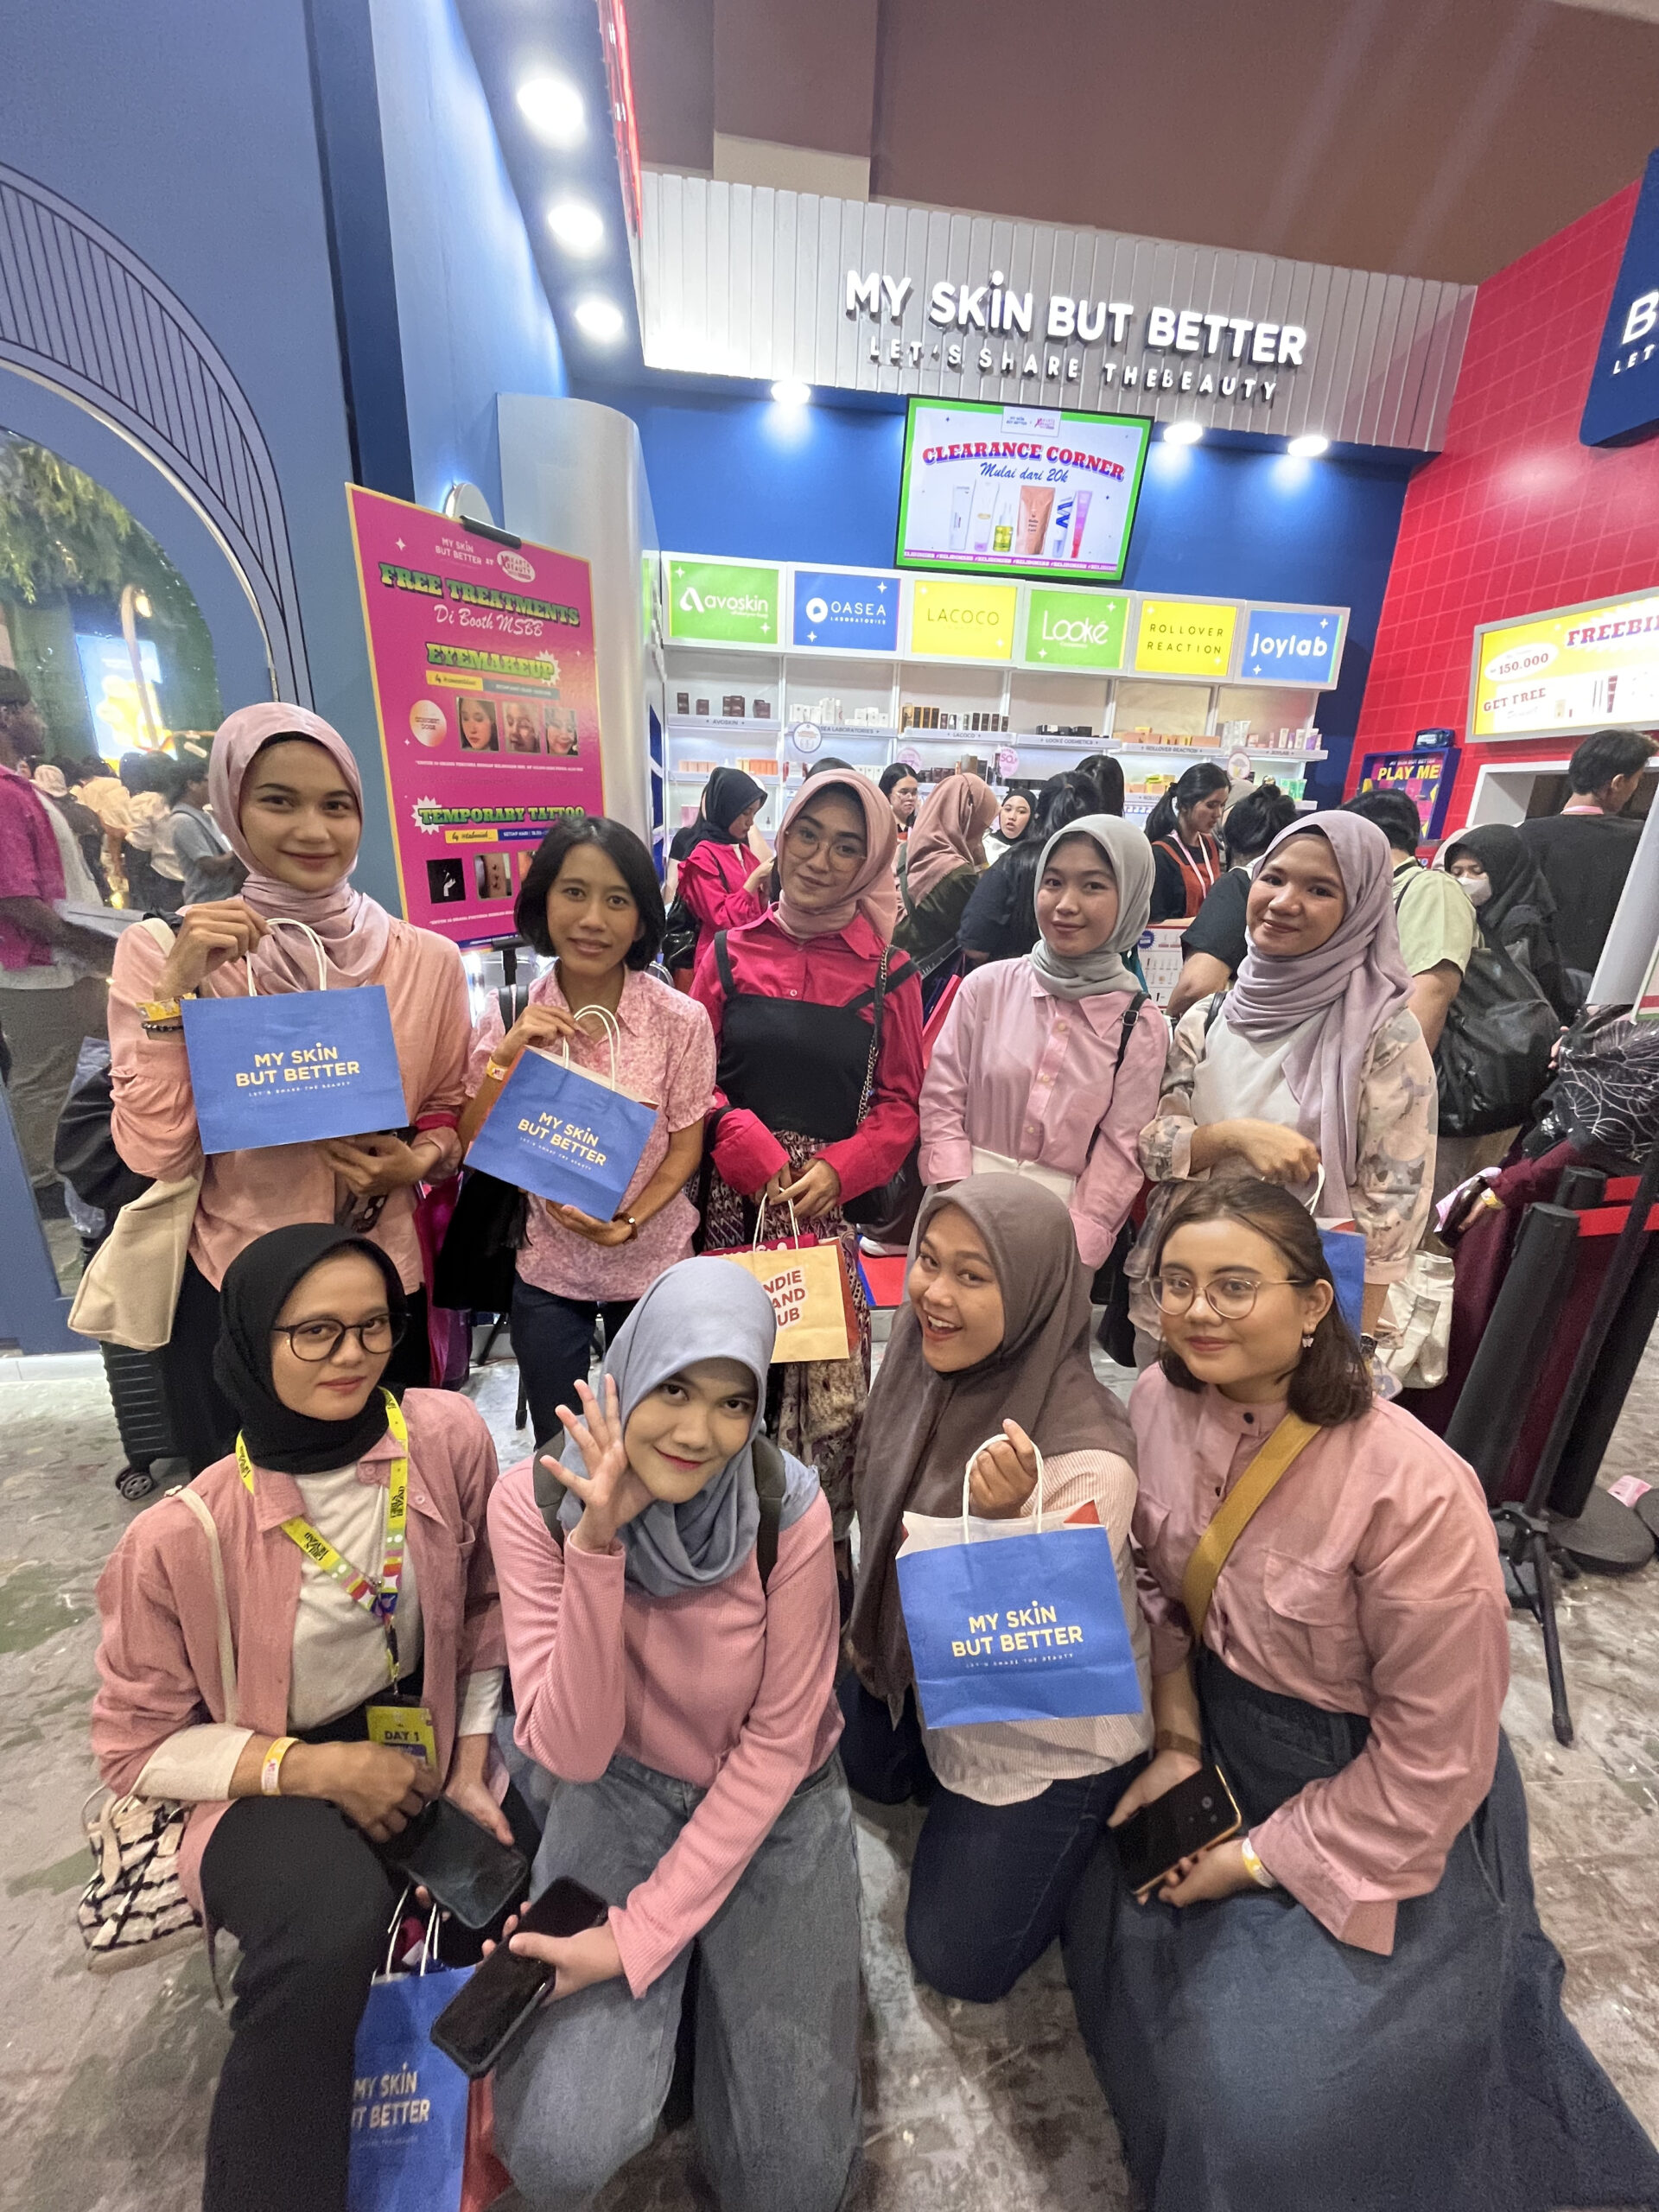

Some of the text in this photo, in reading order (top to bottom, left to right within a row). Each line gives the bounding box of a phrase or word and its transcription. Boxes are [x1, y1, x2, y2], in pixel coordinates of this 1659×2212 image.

[846, 270, 912, 317] MY
[1047, 295, 1134, 344] BUT
[1147, 306, 1307, 367] BETTER
[869, 335, 962, 366] LET'S
[978, 348, 1078, 379] SHARE
[922, 442, 1125, 482] CLEARANCE CORNER
[980, 462, 1069, 483] Mulai dari 20k
[442, 537, 454, 548] MY
[435, 545, 451, 556] BUT
[453, 550, 481, 565] BETTER
[378, 562, 581, 627] FREE TREATMENTS
[704, 594, 768, 613] avoskin
[831, 601, 886, 616] OASEA
[927, 608, 999, 626] LACOCO
[435, 604, 543, 637] Di Booth MSBB
[1150, 623, 1223, 637] ROLLOVER
[1147, 641, 1221, 654] REACTION
[425, 642, 555, 680] EYEMAKEUP
[1499, 652, 1549, 675] 150.000
[1484, 687, 1547, 712] GET FREE
[1377, 764, 1440, 781] PLAY ME
[418, 807, 525, 825] TEMPORARY
[254, 1052, 284, 1068] MY
[235, 1060, 360, 1087] BUT BETTER
[538, 1112, 563, 1130] MY
[518, 1118, 550, 1140] BUT
[550, 1134, 607, 1166] BETTER
[763, 1270, 802, 1294] NDIE
[772, 1287, 805, 1309] AND
[778, 1307, 800, 1327] UB
[969, 1613, 999, 1634] MY
[951, 1625, 1084, 1657] BUT BETTER
[385, 1731, 419, 1742] DAY 1
[353, 2075, 378, 2101] MY
[370, 2099, 430, 2129] BETTER
